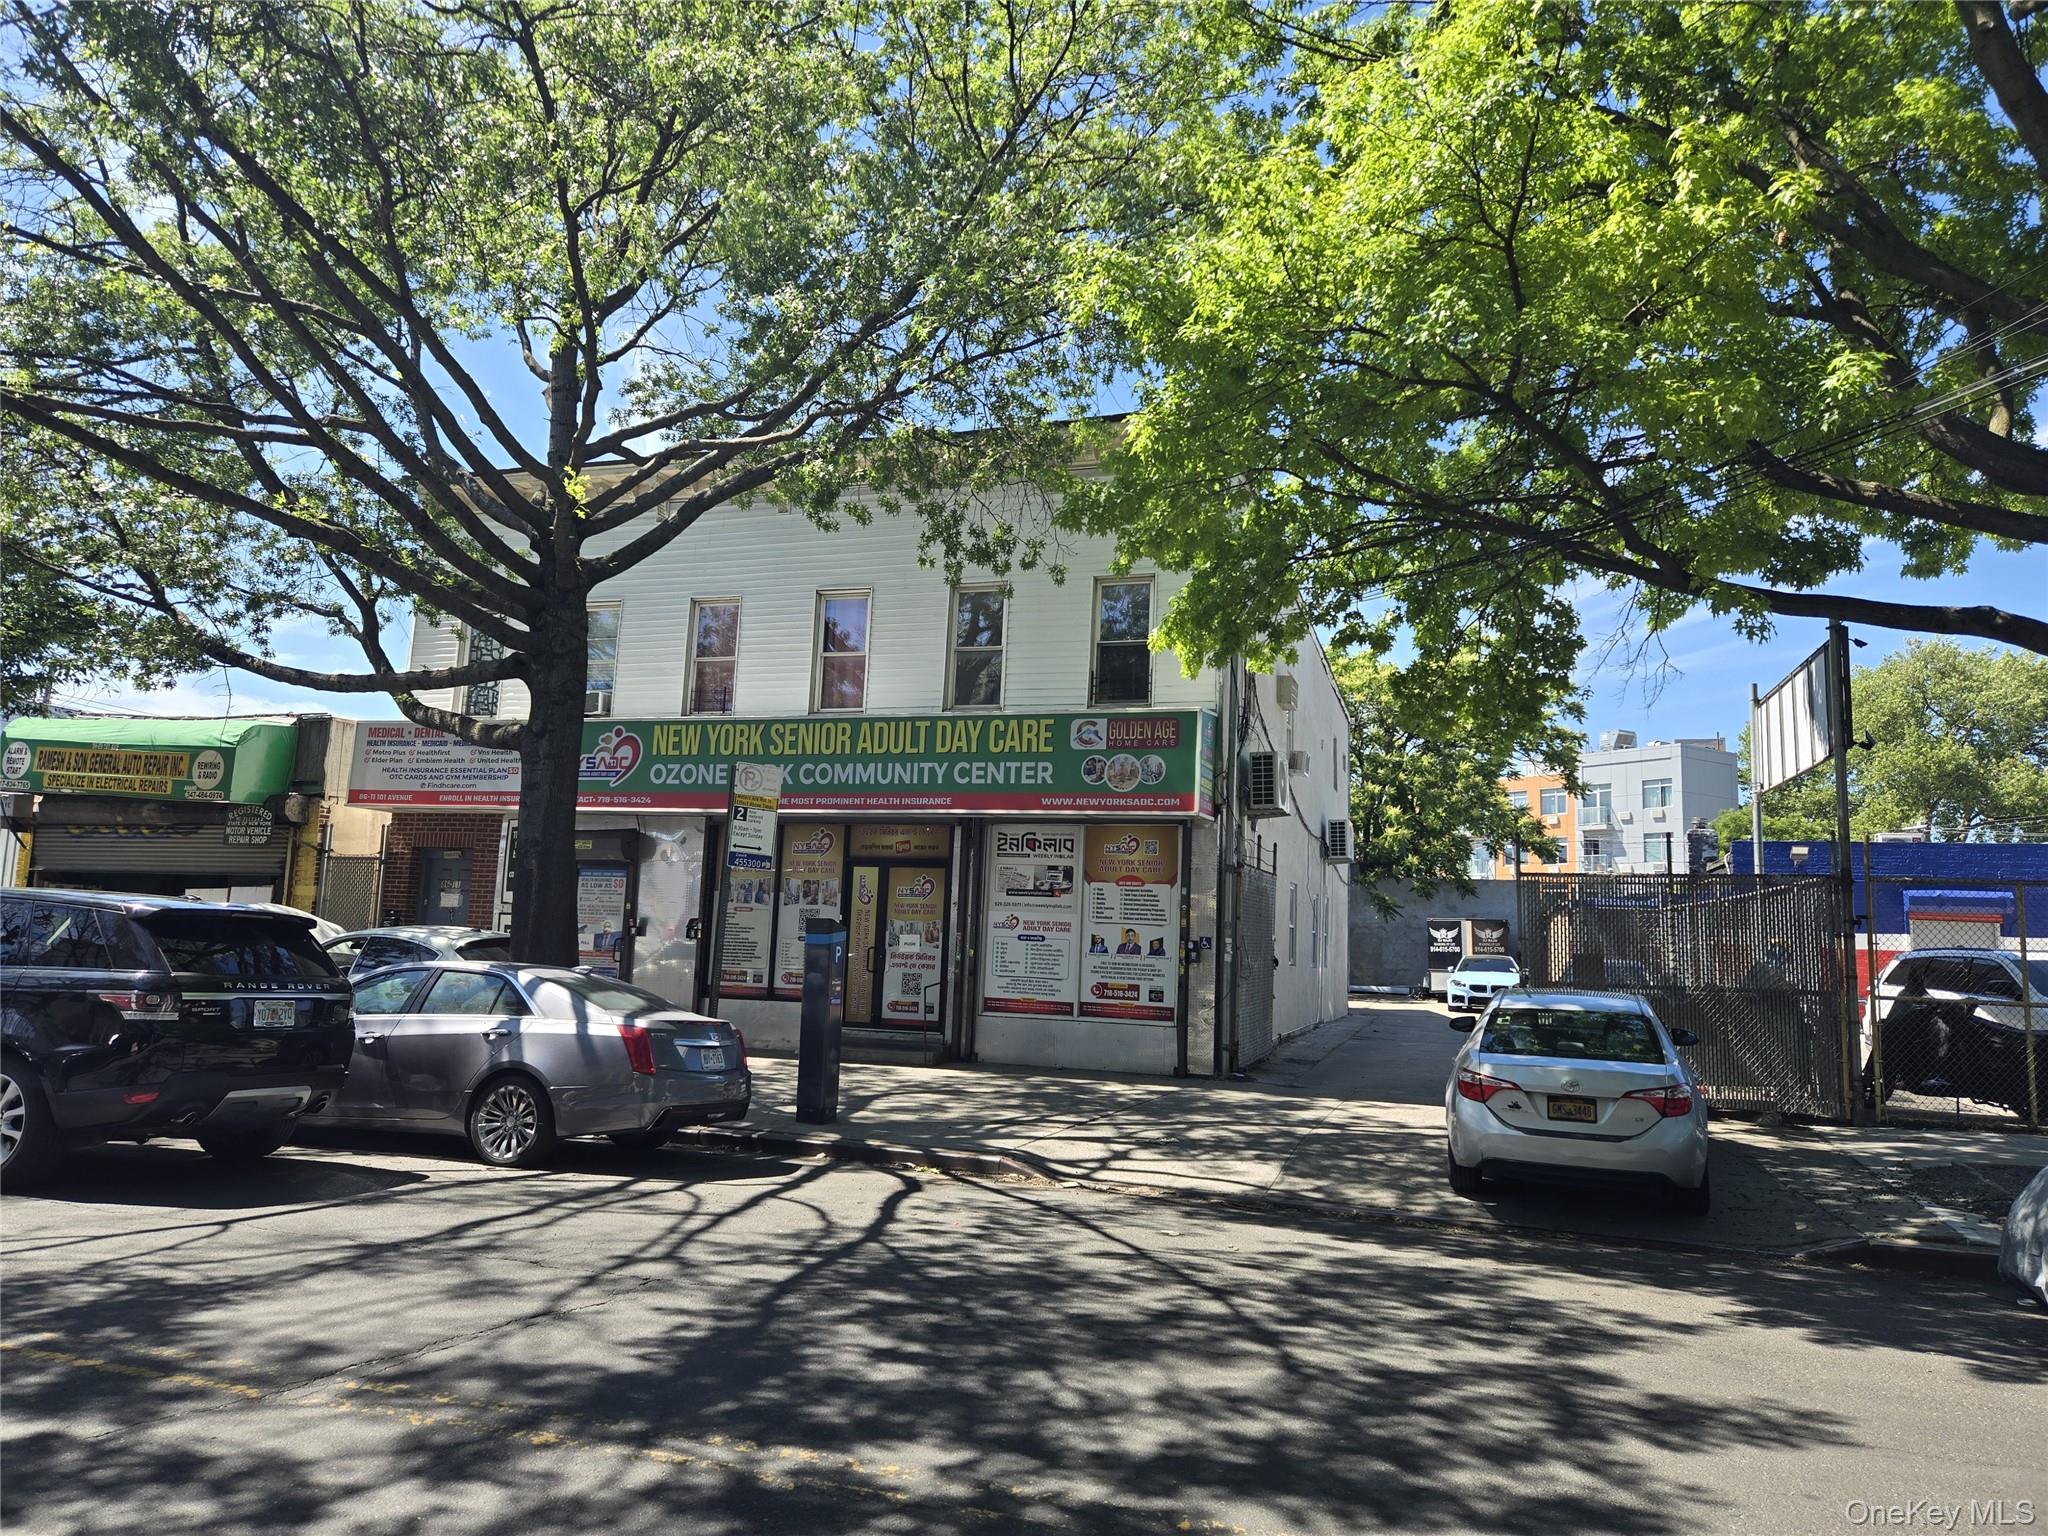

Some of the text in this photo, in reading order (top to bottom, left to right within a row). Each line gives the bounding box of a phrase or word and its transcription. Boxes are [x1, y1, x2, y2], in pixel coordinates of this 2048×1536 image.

[367, 726, 405, 738] MEDICAL
[1109, 720, 1177, 740] GOLDEN AGE
[652, 718, 1055, 756] NEW YORK SENIOR ADULT DAY CARE
[366, 739, 386, 747] HEALTH
[387, 739, 417, 747] INSURANCE
[1146, 739, 1176, 747] CARE
[7, 747, 23, 756] ALARM
[6, 756, 26, 766] REMOTE
[38, 749, 65, 771] RAMESH
[67, 753, 73, 771] &
[74, 752, 88, 772] SON
[88, 753, 121, 774] GENERAL
[122, 754, 143, 775] AUTO
[143, 754, 170, 777] REPAIR
[197, 761, 221, 771] REWIRING
[6, 766, 22, 775] START
[202, 770, 218, 780] RADIO
[650, 762, 728, 785] OZONE
[798, 761, 949, 786] COMMUNITY
[953, 761, 1054, 785] CENTER
[47, 773, 169, 793] SPECIALIZE IN ELECTRICAL REPAIRS
[387, 793, 413, 801] AVENUE
[596, 796, 652, 804] 718-516-3424
[792, 797, 953, 806] MOST PROMINENT HEALTH INSURANCE
[1041, 797, 1180, 806] WWW.NEWYORKSADC.COM
[228, 805, 273, 820] REGISTERED
[736, 807, 744, 820] 2
[225, 826, 272, 836] MOTOR VEHICLE
[228, 835, 268, 845] REPAIR SHOP
[734, 858, 761, 868] 455300
[836, 946, 842, 964] P
[223, 981, 331, 990] RANGE ROVER
[1104, 988, 1138, 999] 718-516-3424
